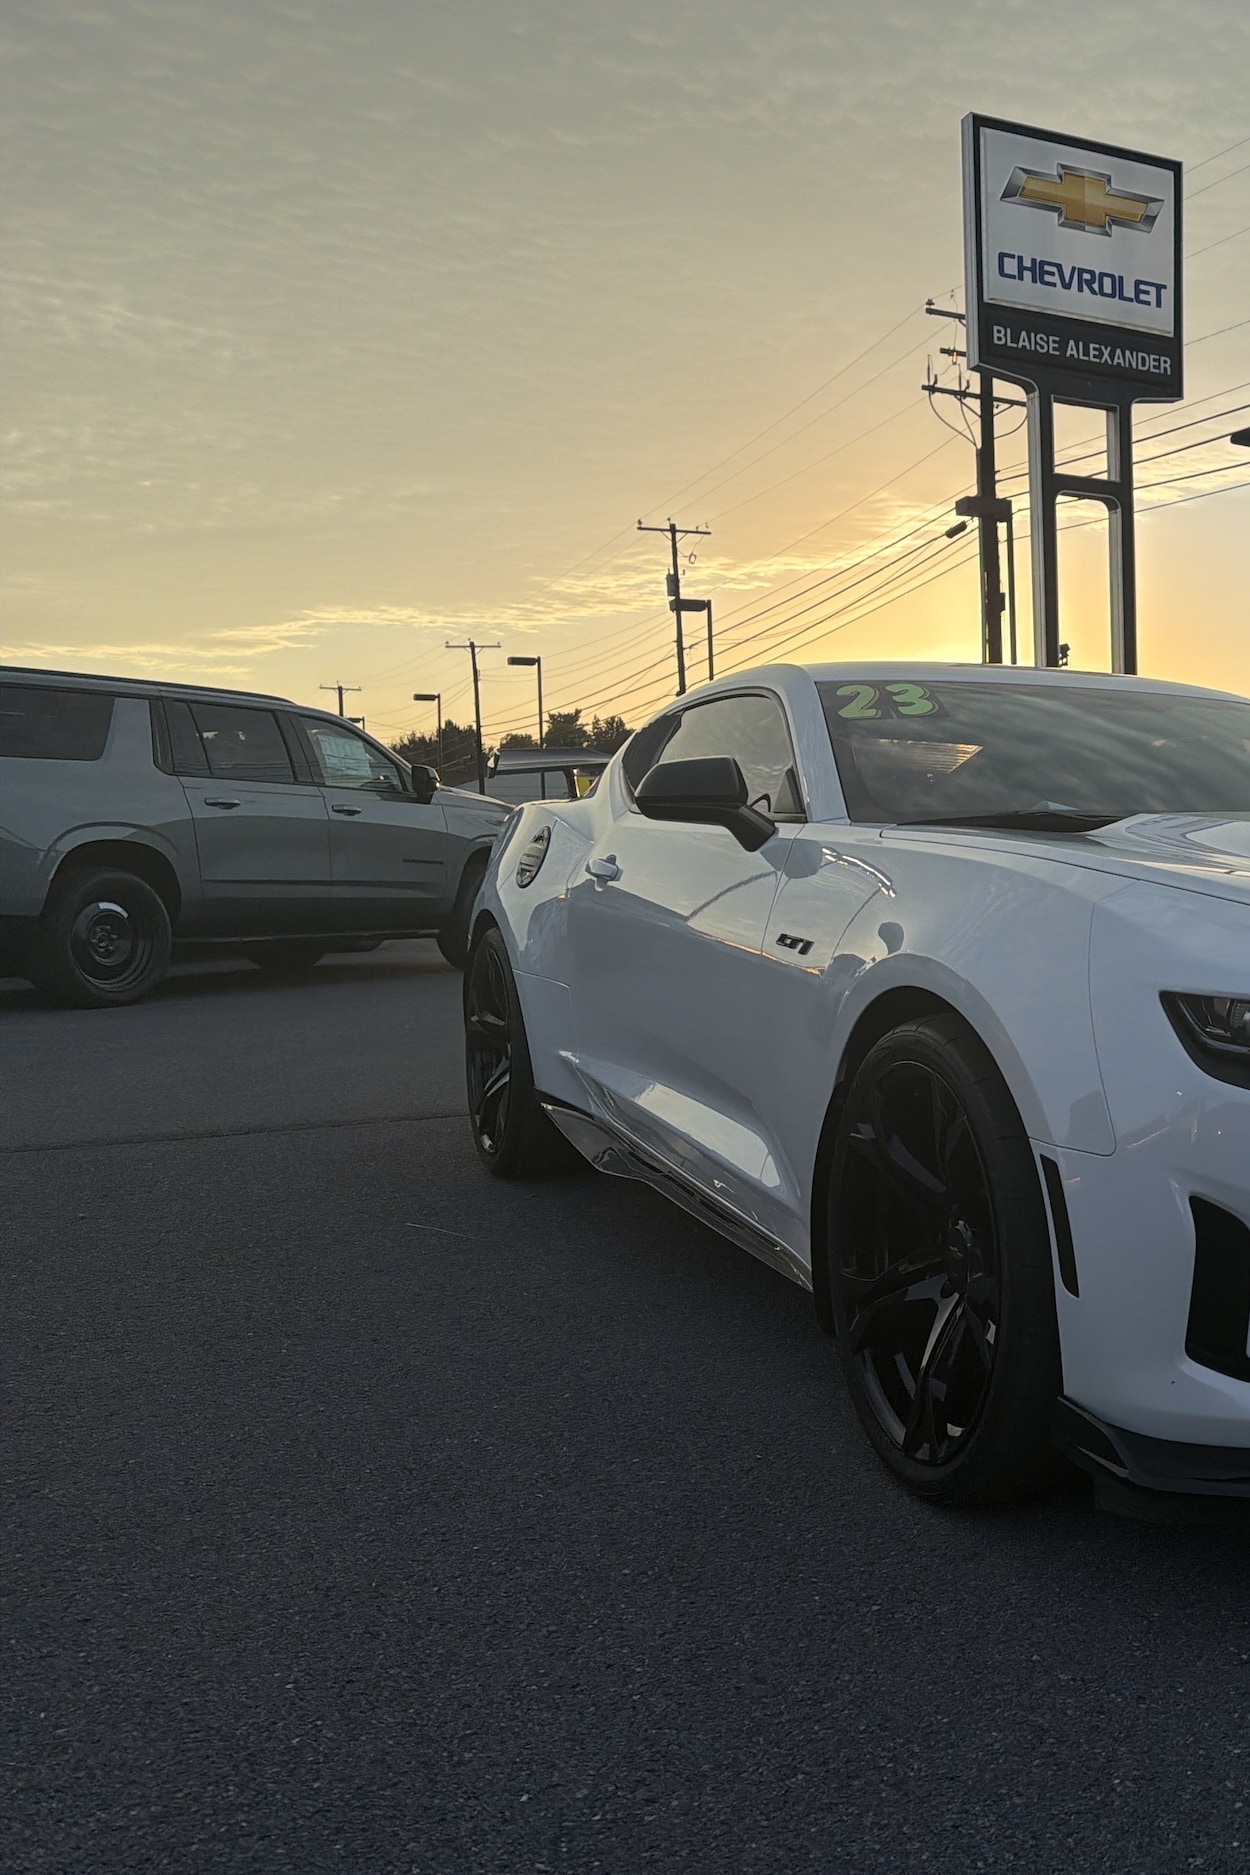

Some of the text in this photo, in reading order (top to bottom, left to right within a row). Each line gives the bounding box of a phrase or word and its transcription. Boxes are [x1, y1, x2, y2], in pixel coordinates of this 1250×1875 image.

[998, 252, 1167, 308] CHEVROLET
[993, 325, 1171, 375] BLAISE ALEXANDER
[835, 683, 939, 720] 23
